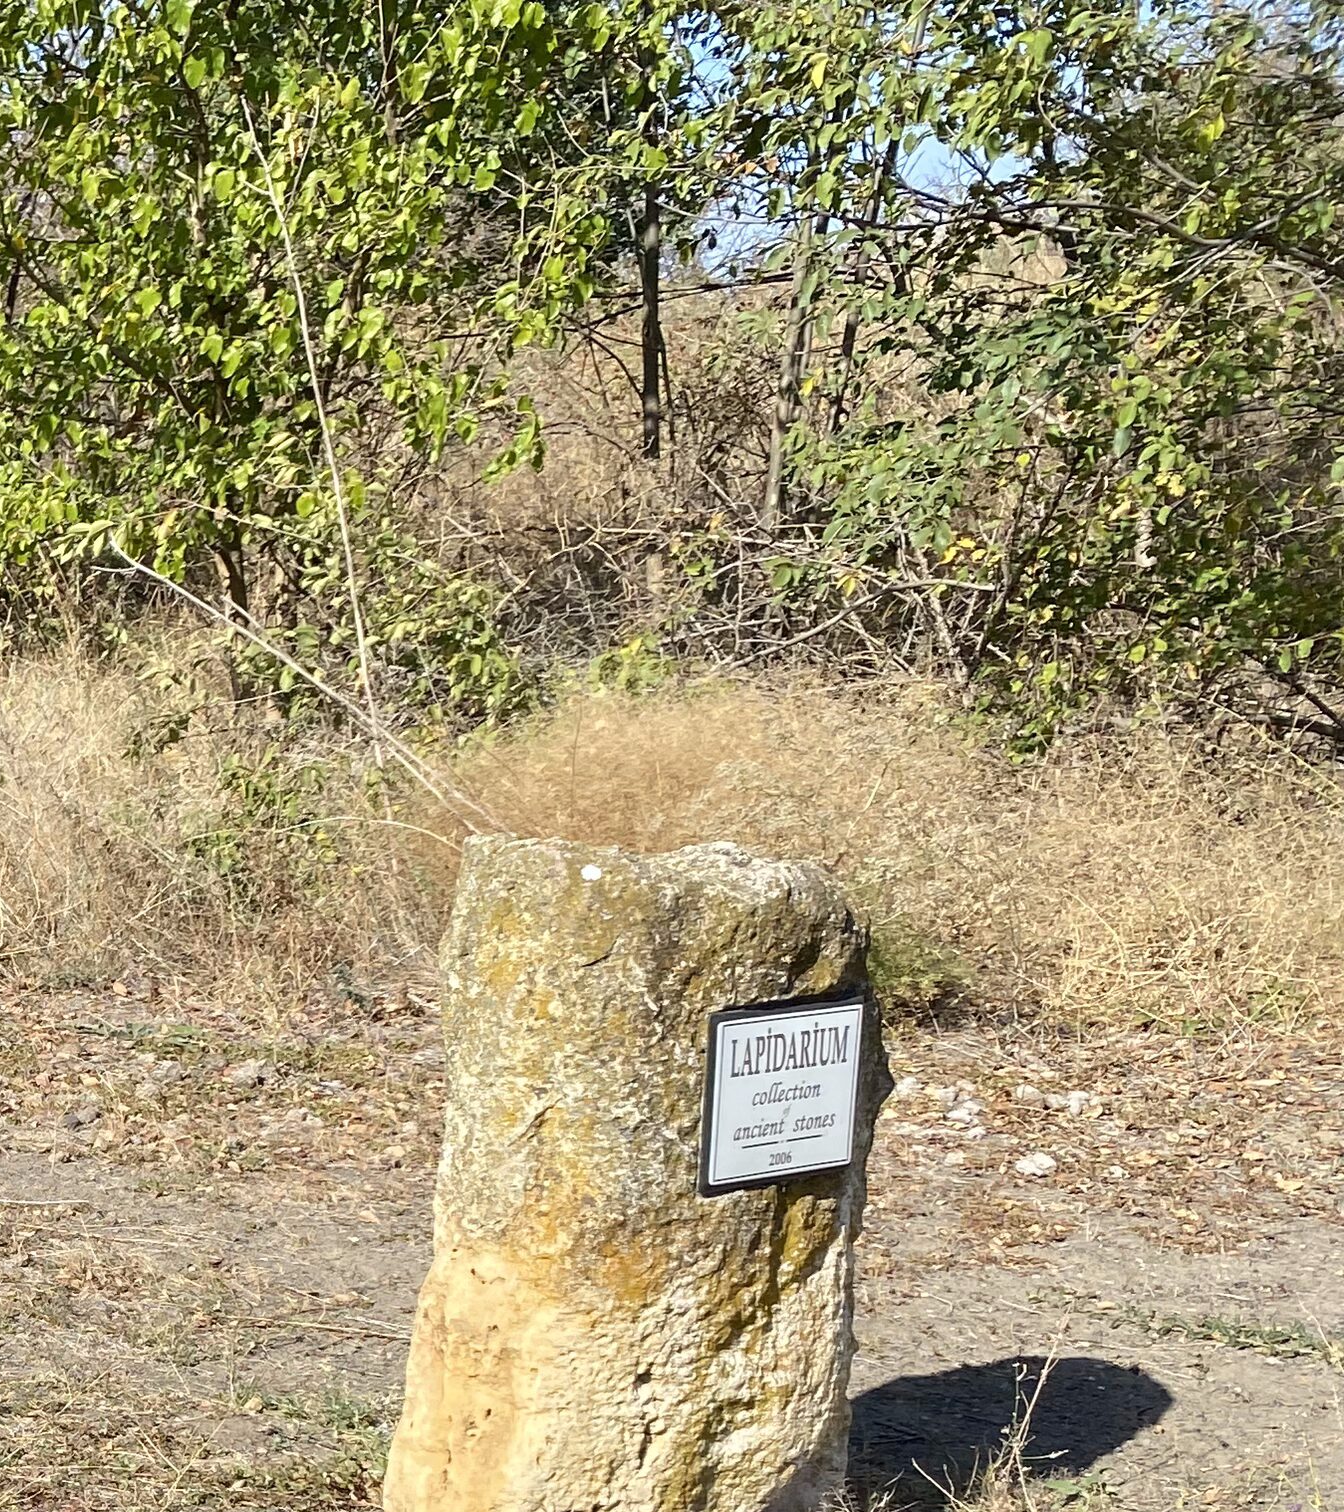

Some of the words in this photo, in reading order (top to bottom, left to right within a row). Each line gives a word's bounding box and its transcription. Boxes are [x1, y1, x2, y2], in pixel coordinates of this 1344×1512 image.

[752, 1080, 821, 1106] collection
[733, 1118, 784, 1141] ancient
[793, 1113, 836, 1132] stones
[769, 1151, 792, 1166] 2006
